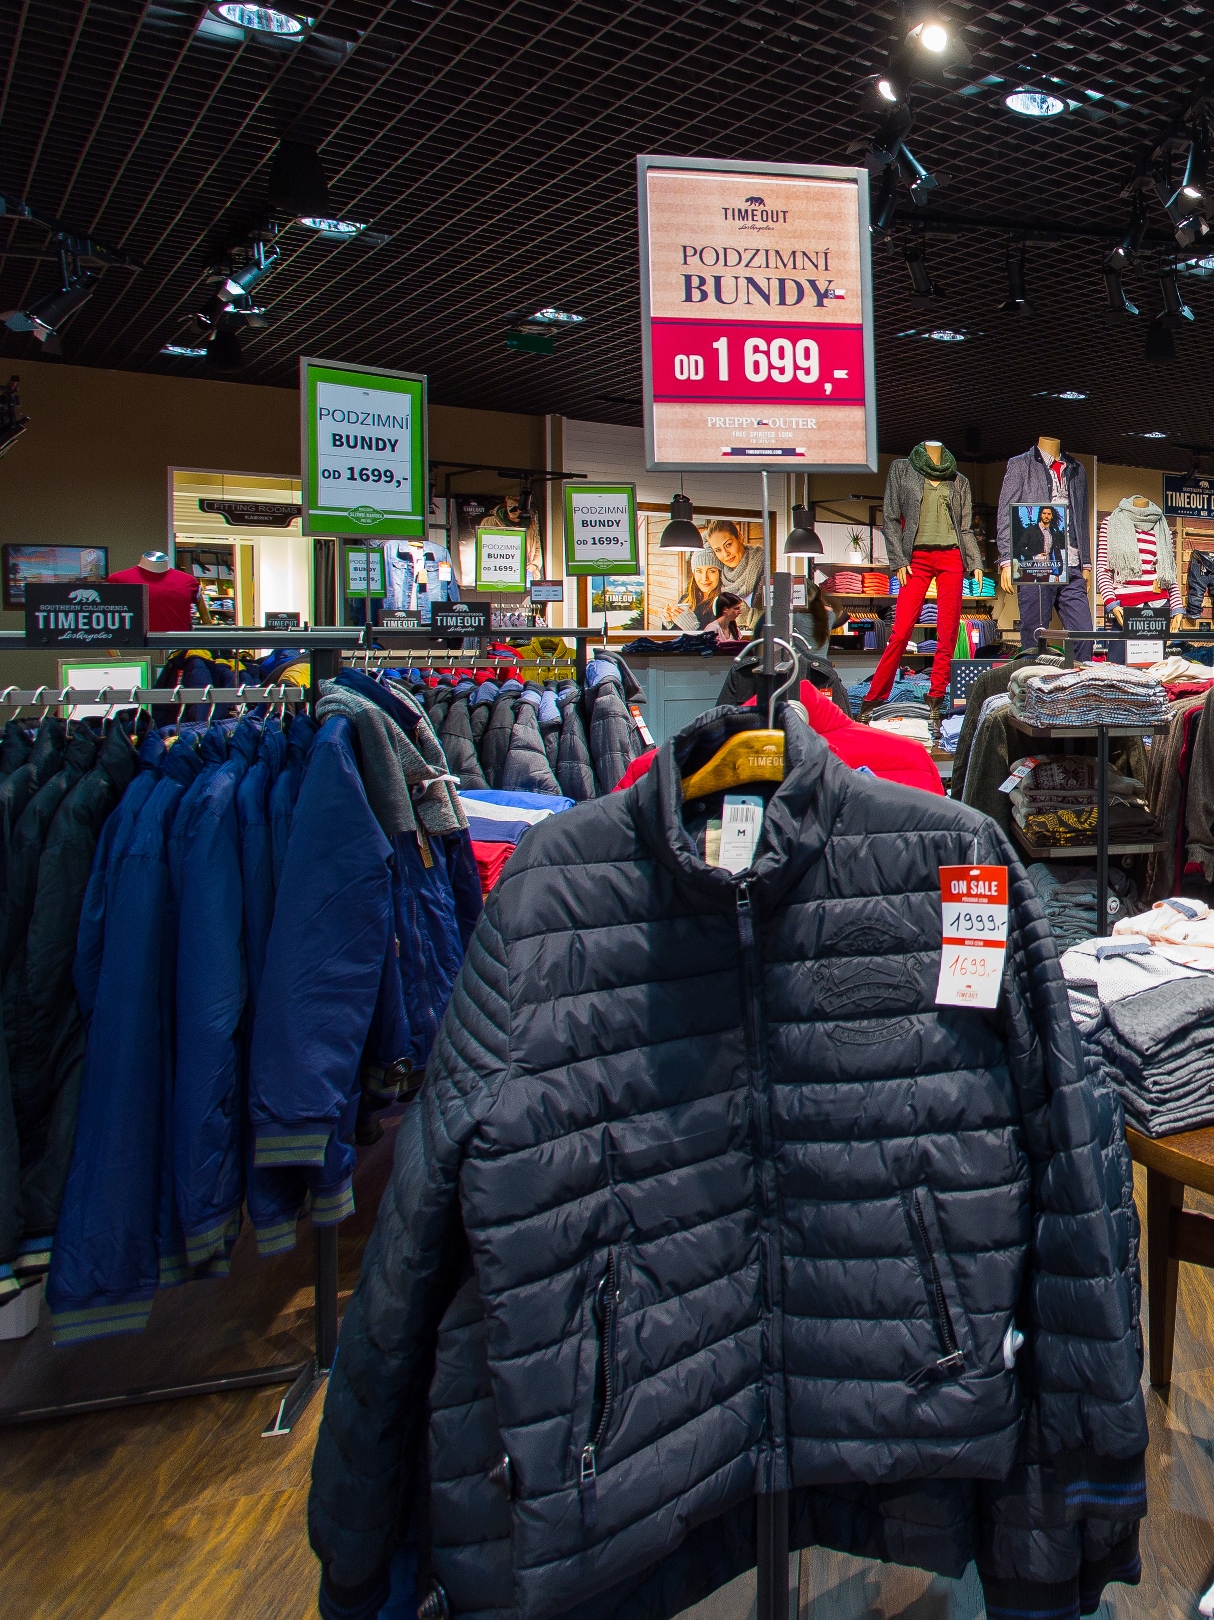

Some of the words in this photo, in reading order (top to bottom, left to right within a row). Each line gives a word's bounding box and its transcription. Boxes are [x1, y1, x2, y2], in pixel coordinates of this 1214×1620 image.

[722, 207, 789, 224] TIMEOUT
[680, 244, 831, 271] PODZIMNÍ
[680, 273, 835, 308] BUNDY
[674, 354, 704, 381] OD
[319, 406, 410, 430] PODZIMNÍ
[707, 416, 759, 428] PREPPY
[768, 417, 817, 429] OUTER
[332, 432, 399, 453] BUNDY
[322, 468, 341, 480] OD
[346, 466, 409, 489] 1699,-
[1166, 491, 1209, 509] TIMEOUT
[214, 503, 256, 511] FITTING
[258, 505, 298, 514] ROOMS
[573, 504, 628, 515] PODZIMNÍ
[581, 519, 621, 528] BUNDY
[482, 543, 521, 551] PODZIMNÍ
[590, 536, 629, 547] 1699,-
[493, 565, 519, 573] 1699,-
[604, 594, 636, 602] TIMEOUT
[35, 612, 134, 630] TIMEOUT
[435, 616, 486, 627] TIMEOUT
[1127, 621, 1167, 630] TIMEOUT
[950, 880, 967, 894] ON
[970, 881, 998, 895] SALE
[949, 912, 1007, 932] 1999,-
[949, 954, 997, 977] 1699,-
